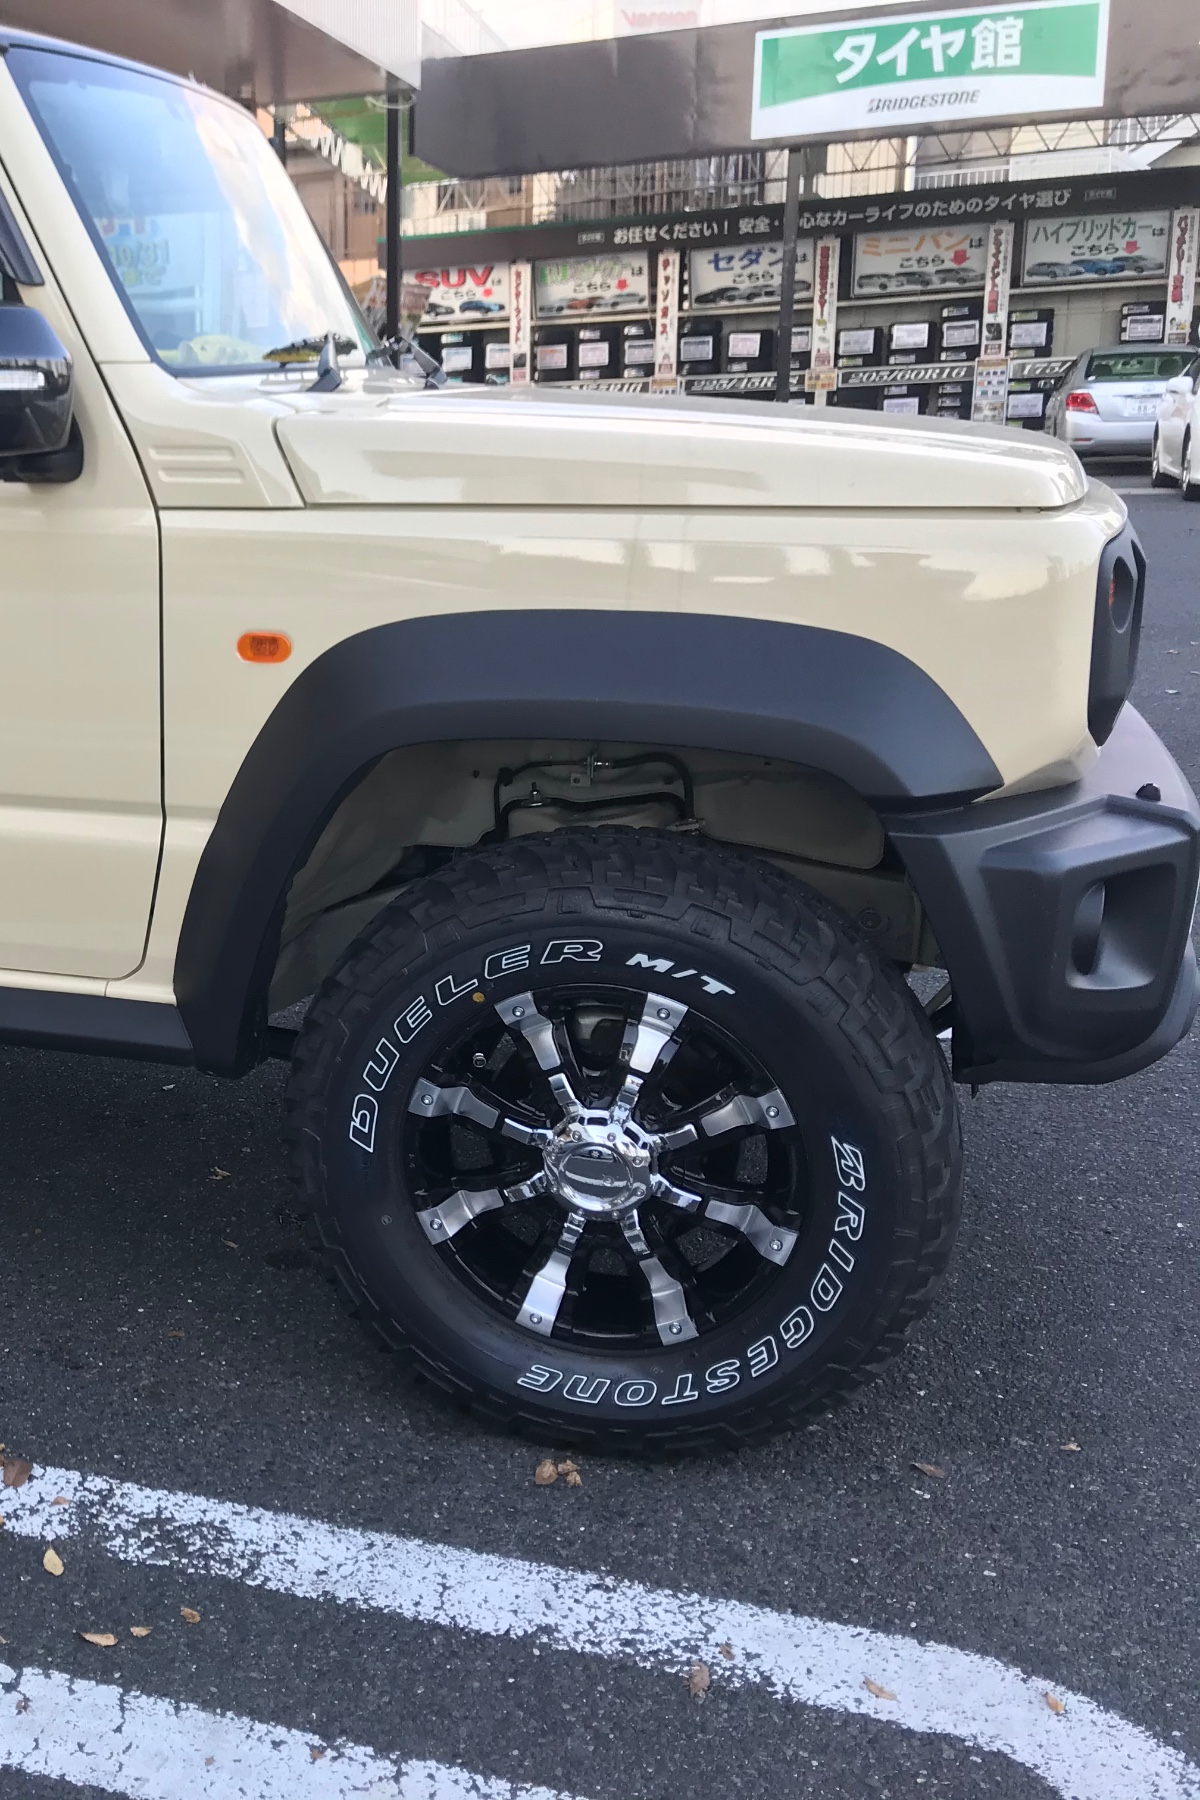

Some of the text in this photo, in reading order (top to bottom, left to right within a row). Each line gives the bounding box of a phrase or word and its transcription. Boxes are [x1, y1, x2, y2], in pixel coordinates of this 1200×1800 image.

[833, 16, 1025, 84] タイヤ館
[866, 89, 981, 114] BRIDGESTONE
[1071, 243, 1119, 256] こちら
[899, 254, 945, 269] こちら
[733, 270, 775, 284] こちら
[848, 364, 968, 383] 205/60R16
[349, 939, 736, 1152] DUELER M/T
[517, 1136, 867, 1406] BRIDGESTONE
